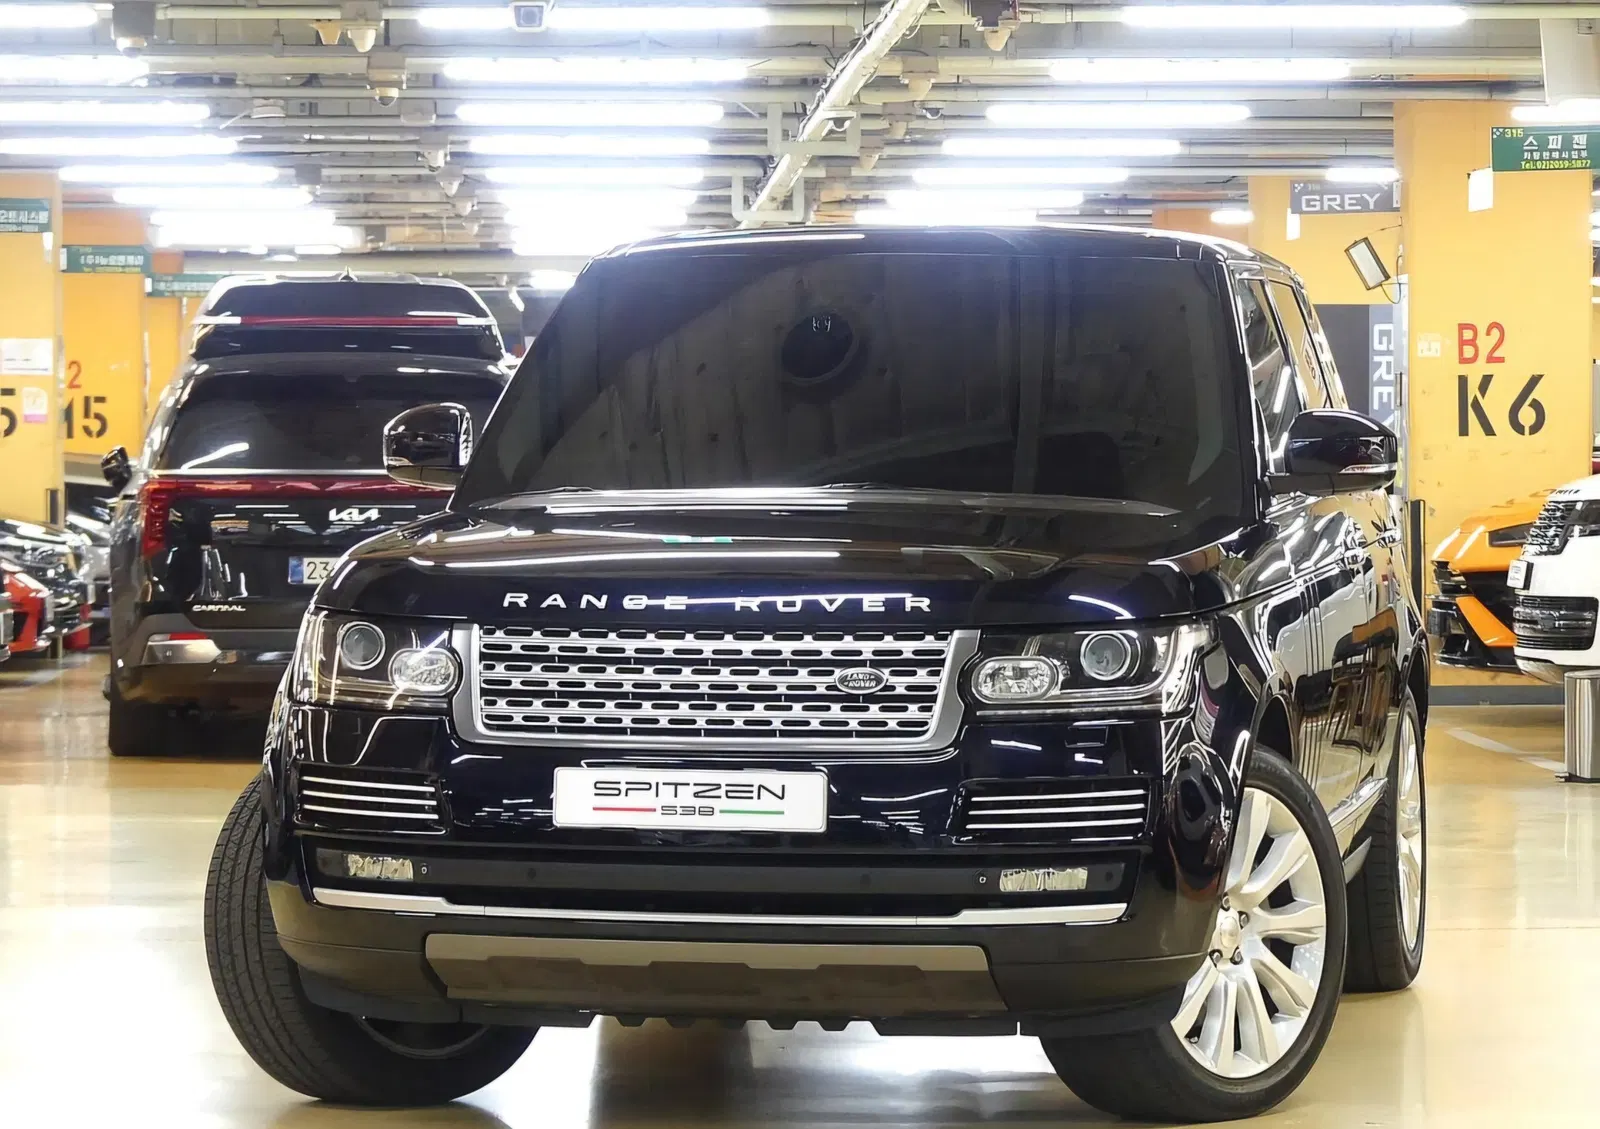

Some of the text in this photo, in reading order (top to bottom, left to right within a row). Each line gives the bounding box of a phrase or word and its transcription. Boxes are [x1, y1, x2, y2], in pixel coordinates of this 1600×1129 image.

[1523, 134, 1588, 150] 스피젠
[1301, 193, 1381, 211] GREY
[1457, 322, 1506, 364] B2
[503, 592, 931, 612] RANGE ROVER
[593, 781, 786, 801] SPITZEN
